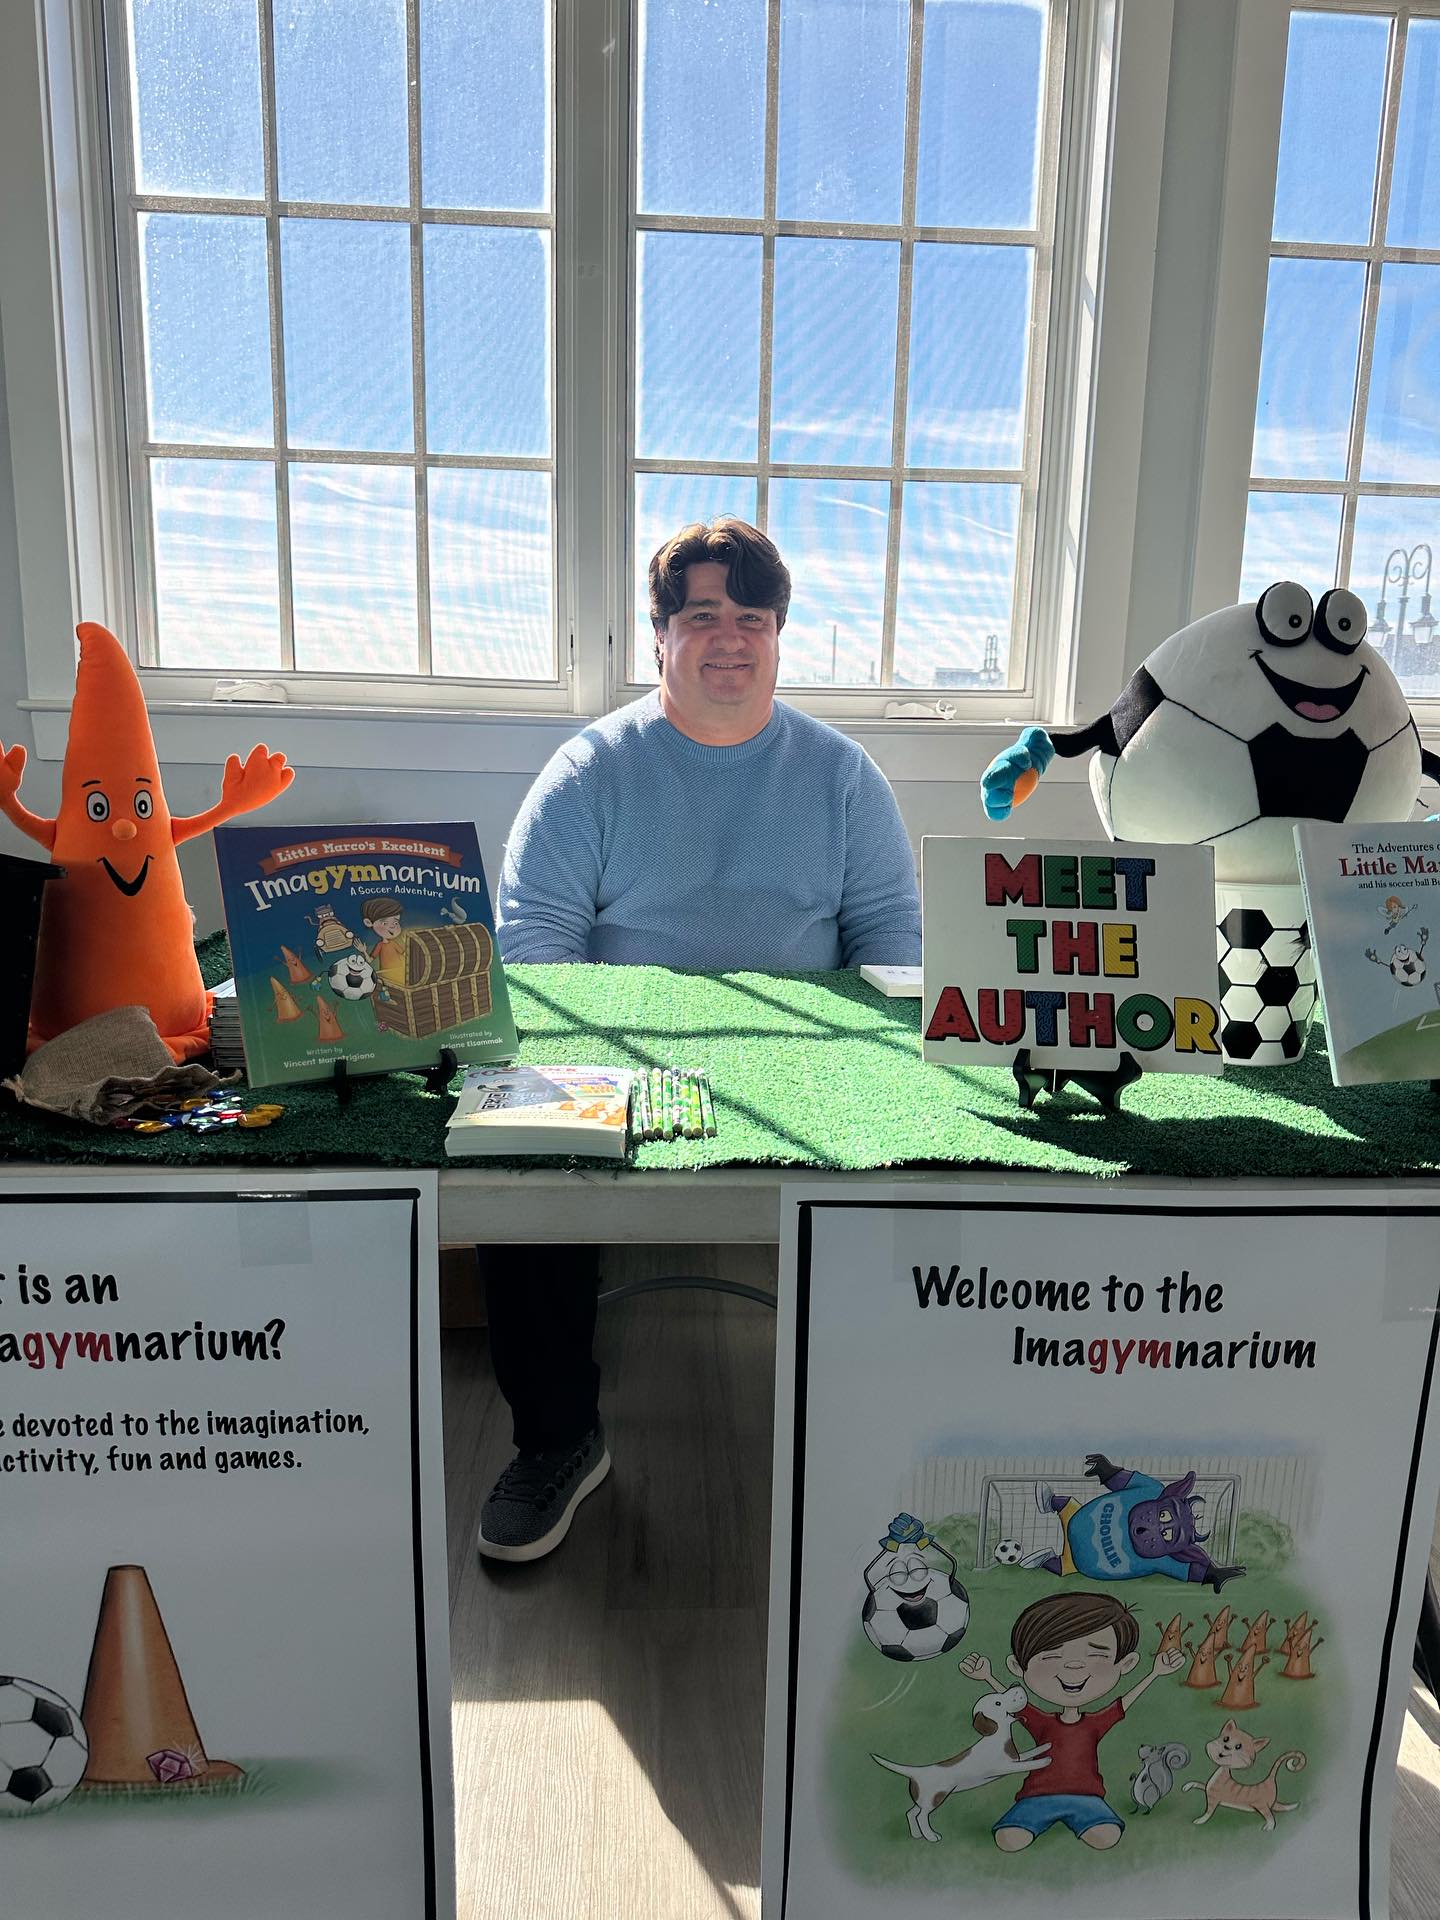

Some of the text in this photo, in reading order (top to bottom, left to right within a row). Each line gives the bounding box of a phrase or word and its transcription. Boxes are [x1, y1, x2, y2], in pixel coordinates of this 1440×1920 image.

[277, 841, 446, 864] Little Marco's Excellent
[1352, 843, 1374, 854] The
[1377, 843, 1434, 854] Adventures
[1339, 855, 1440, 877] Little Ma
[244, 864, 480, 912] Imagymnarium
[350, 885, 444, 898] A Soccer Adventure
[985, 853, 1155, 911] MEET
[1358, 881, 1374, 889] and
[1375, 880, 1387, 889] his
[1414, 878, 1430, 888] ball
[1007, 919, 1139, 978] THE
[925, 986, 1222, 1054] AUTHOR
[283, 1058, 316, 1069] Vincent
[334, 1046, 343, 1054] by
[18, 1264, 52, 1304] is
[65, 1274, 119, 1304] an
[912, 1265, 1224, 1313] Welcome to the
[1013, 1326, 1316, 1374] Imagymnarium
[12, 1412, 114, 1437] devoted
[120, 1411, 149, 1437] to
[155, 1409, 200, 1436] the
[207, 1409, 370, 1439] imagination,
[0, 1445, 303, 1476] ctivity, fun and games.
